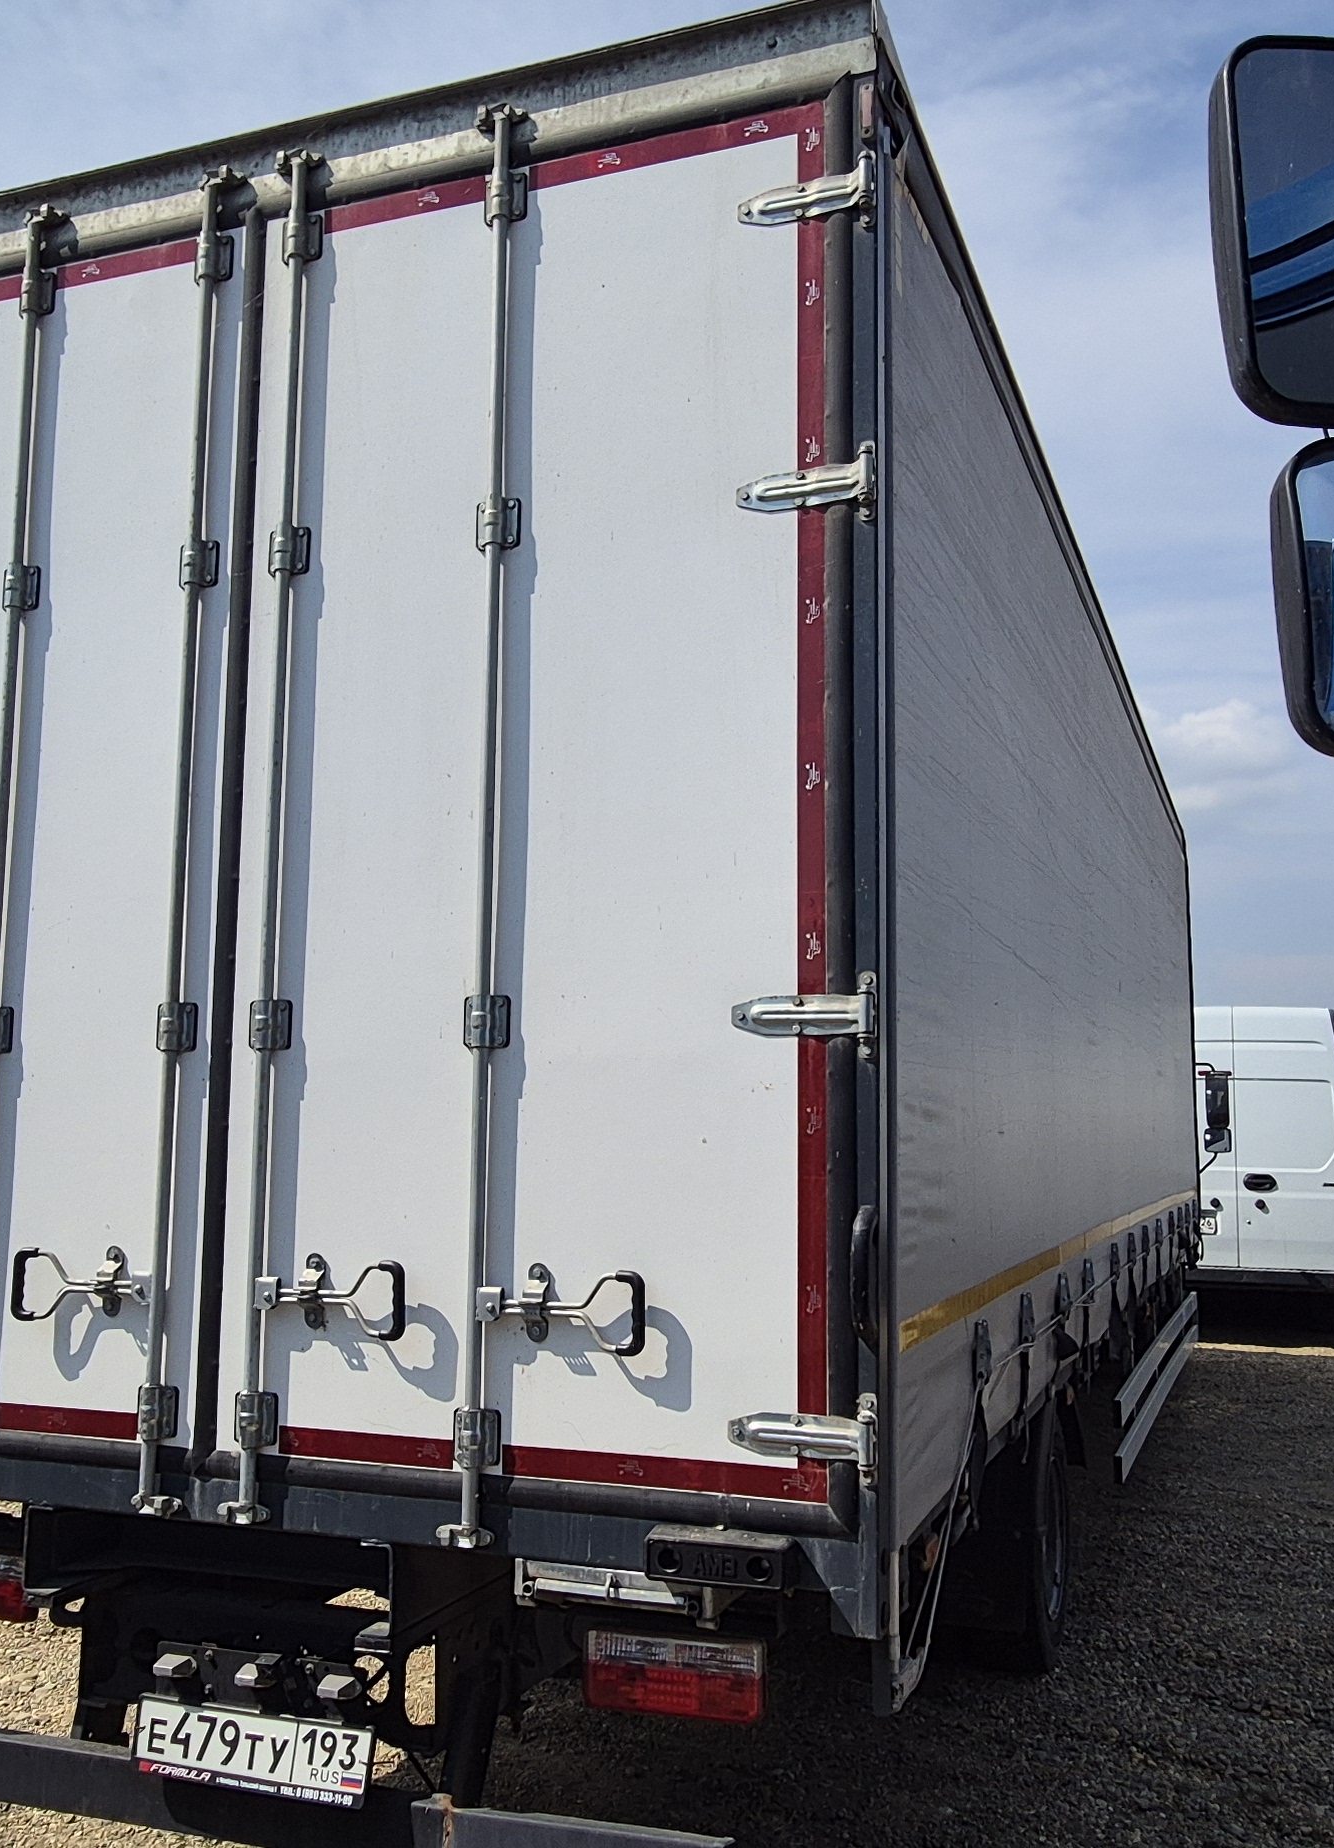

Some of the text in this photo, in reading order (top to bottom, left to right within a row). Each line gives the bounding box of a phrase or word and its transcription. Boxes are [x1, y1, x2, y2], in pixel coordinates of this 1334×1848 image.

[301, 1728, 360, 1771] 193
[149, 1763, 212, 1783] FORMULA
[309, 1767, 340, 1784] RUS
